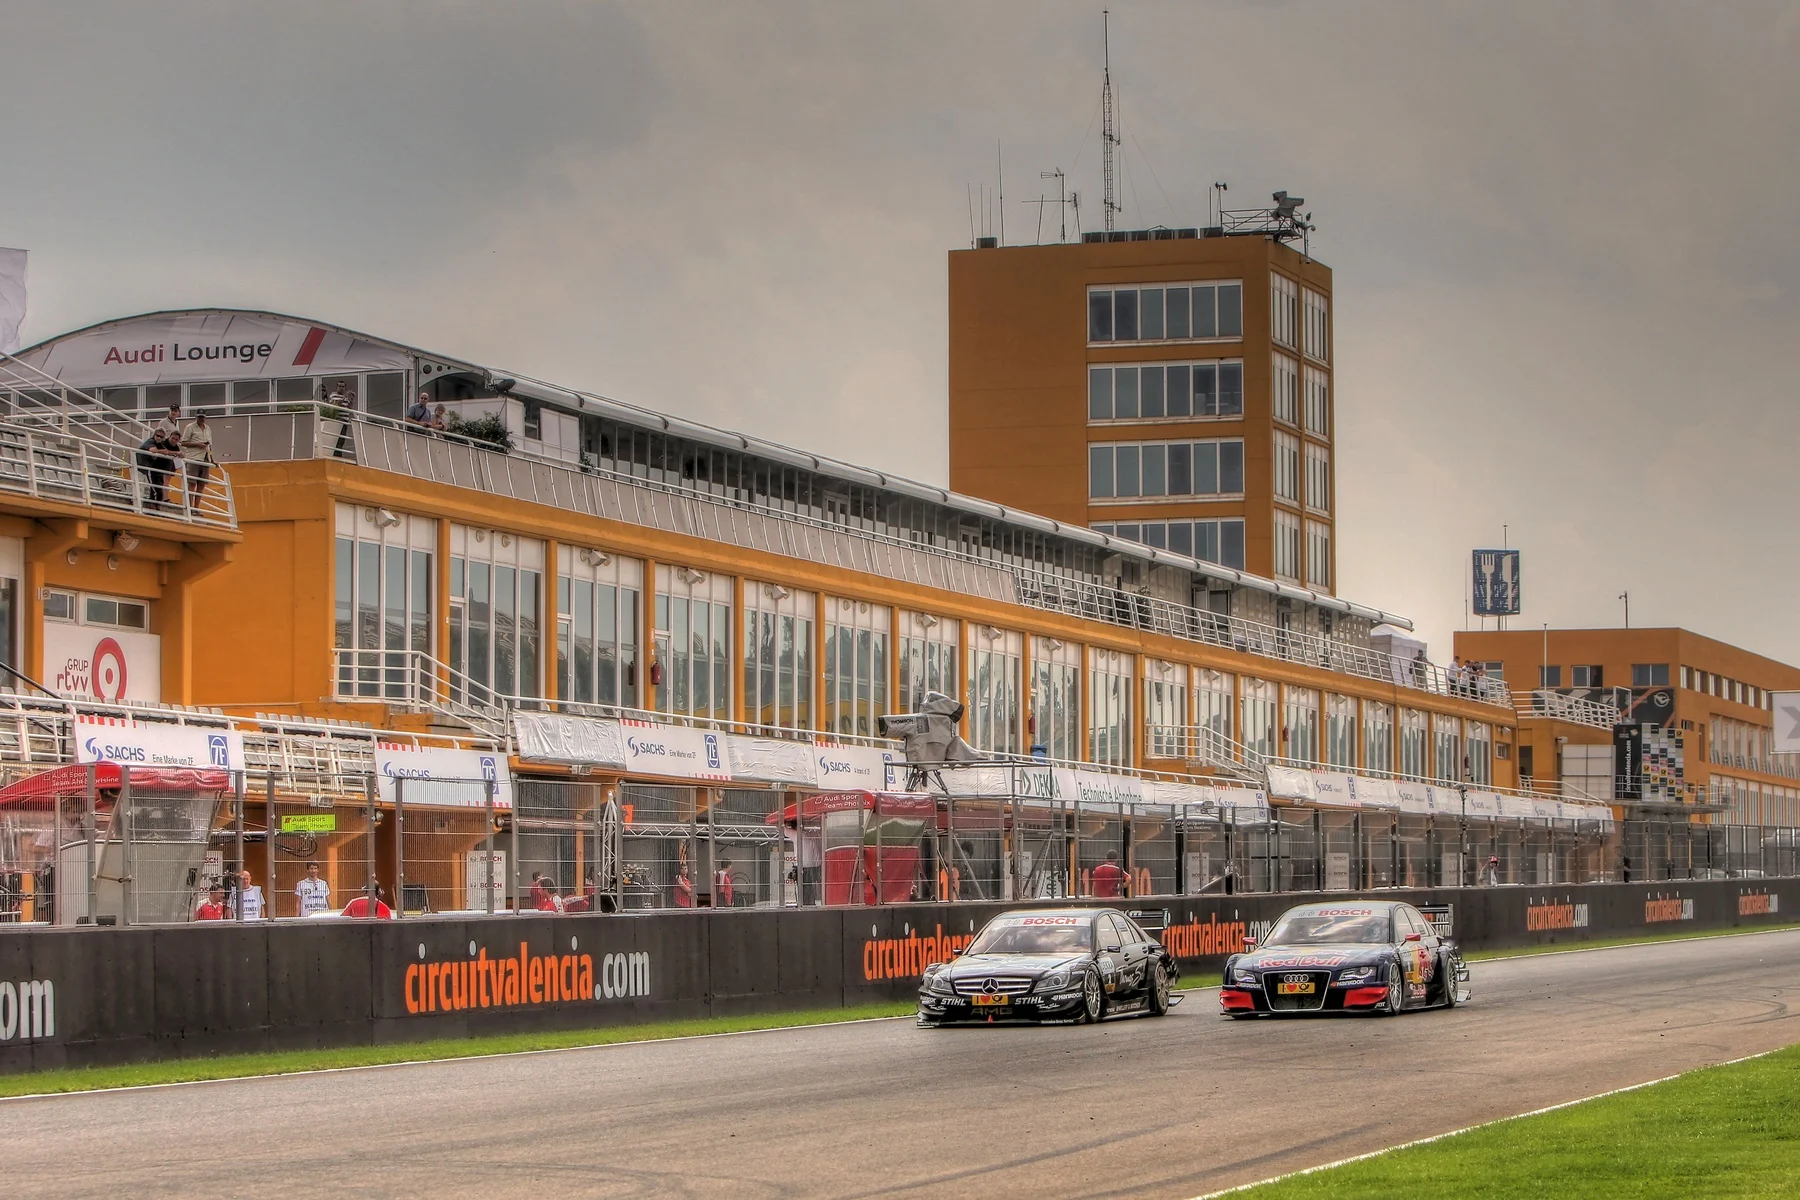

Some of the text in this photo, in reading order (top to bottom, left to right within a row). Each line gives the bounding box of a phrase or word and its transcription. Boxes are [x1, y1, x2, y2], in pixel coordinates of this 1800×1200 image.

[103, 343, 273, 365] Audi Lounge
[67, 658, 89, 672] GRUP
[56, 665, 89, 692] rtvv
[105, 745, 146, 762] SACHS
[152, 754, 163, 763] Eine
[163, 755, 178, 764] Marke
[187, 758, 194, 766] ZF
[639, 742, 666, 756] SACHS
[398, 767, 431, 781] SACHS
[829, 761, 851, 773] SACHS
[84, 777, 119, 785] Sortsline
[843, 799, 871, 807] Phoix
[1527, 894, 1588, 931] circuitvalencia.com
[1022, 917, 1077, 926] BOSCH
[863, 918, 974, 981] circuitvalen
[1259, 955, 1346, 969] Red Bull
[405, 935, 651, 1014] circuitvalencia.com
[940, 997, 967, 1006] STIHL
[1014, 996, 1045, 1006] STIHL
[970, 1007, 1014, 1016] AMG
